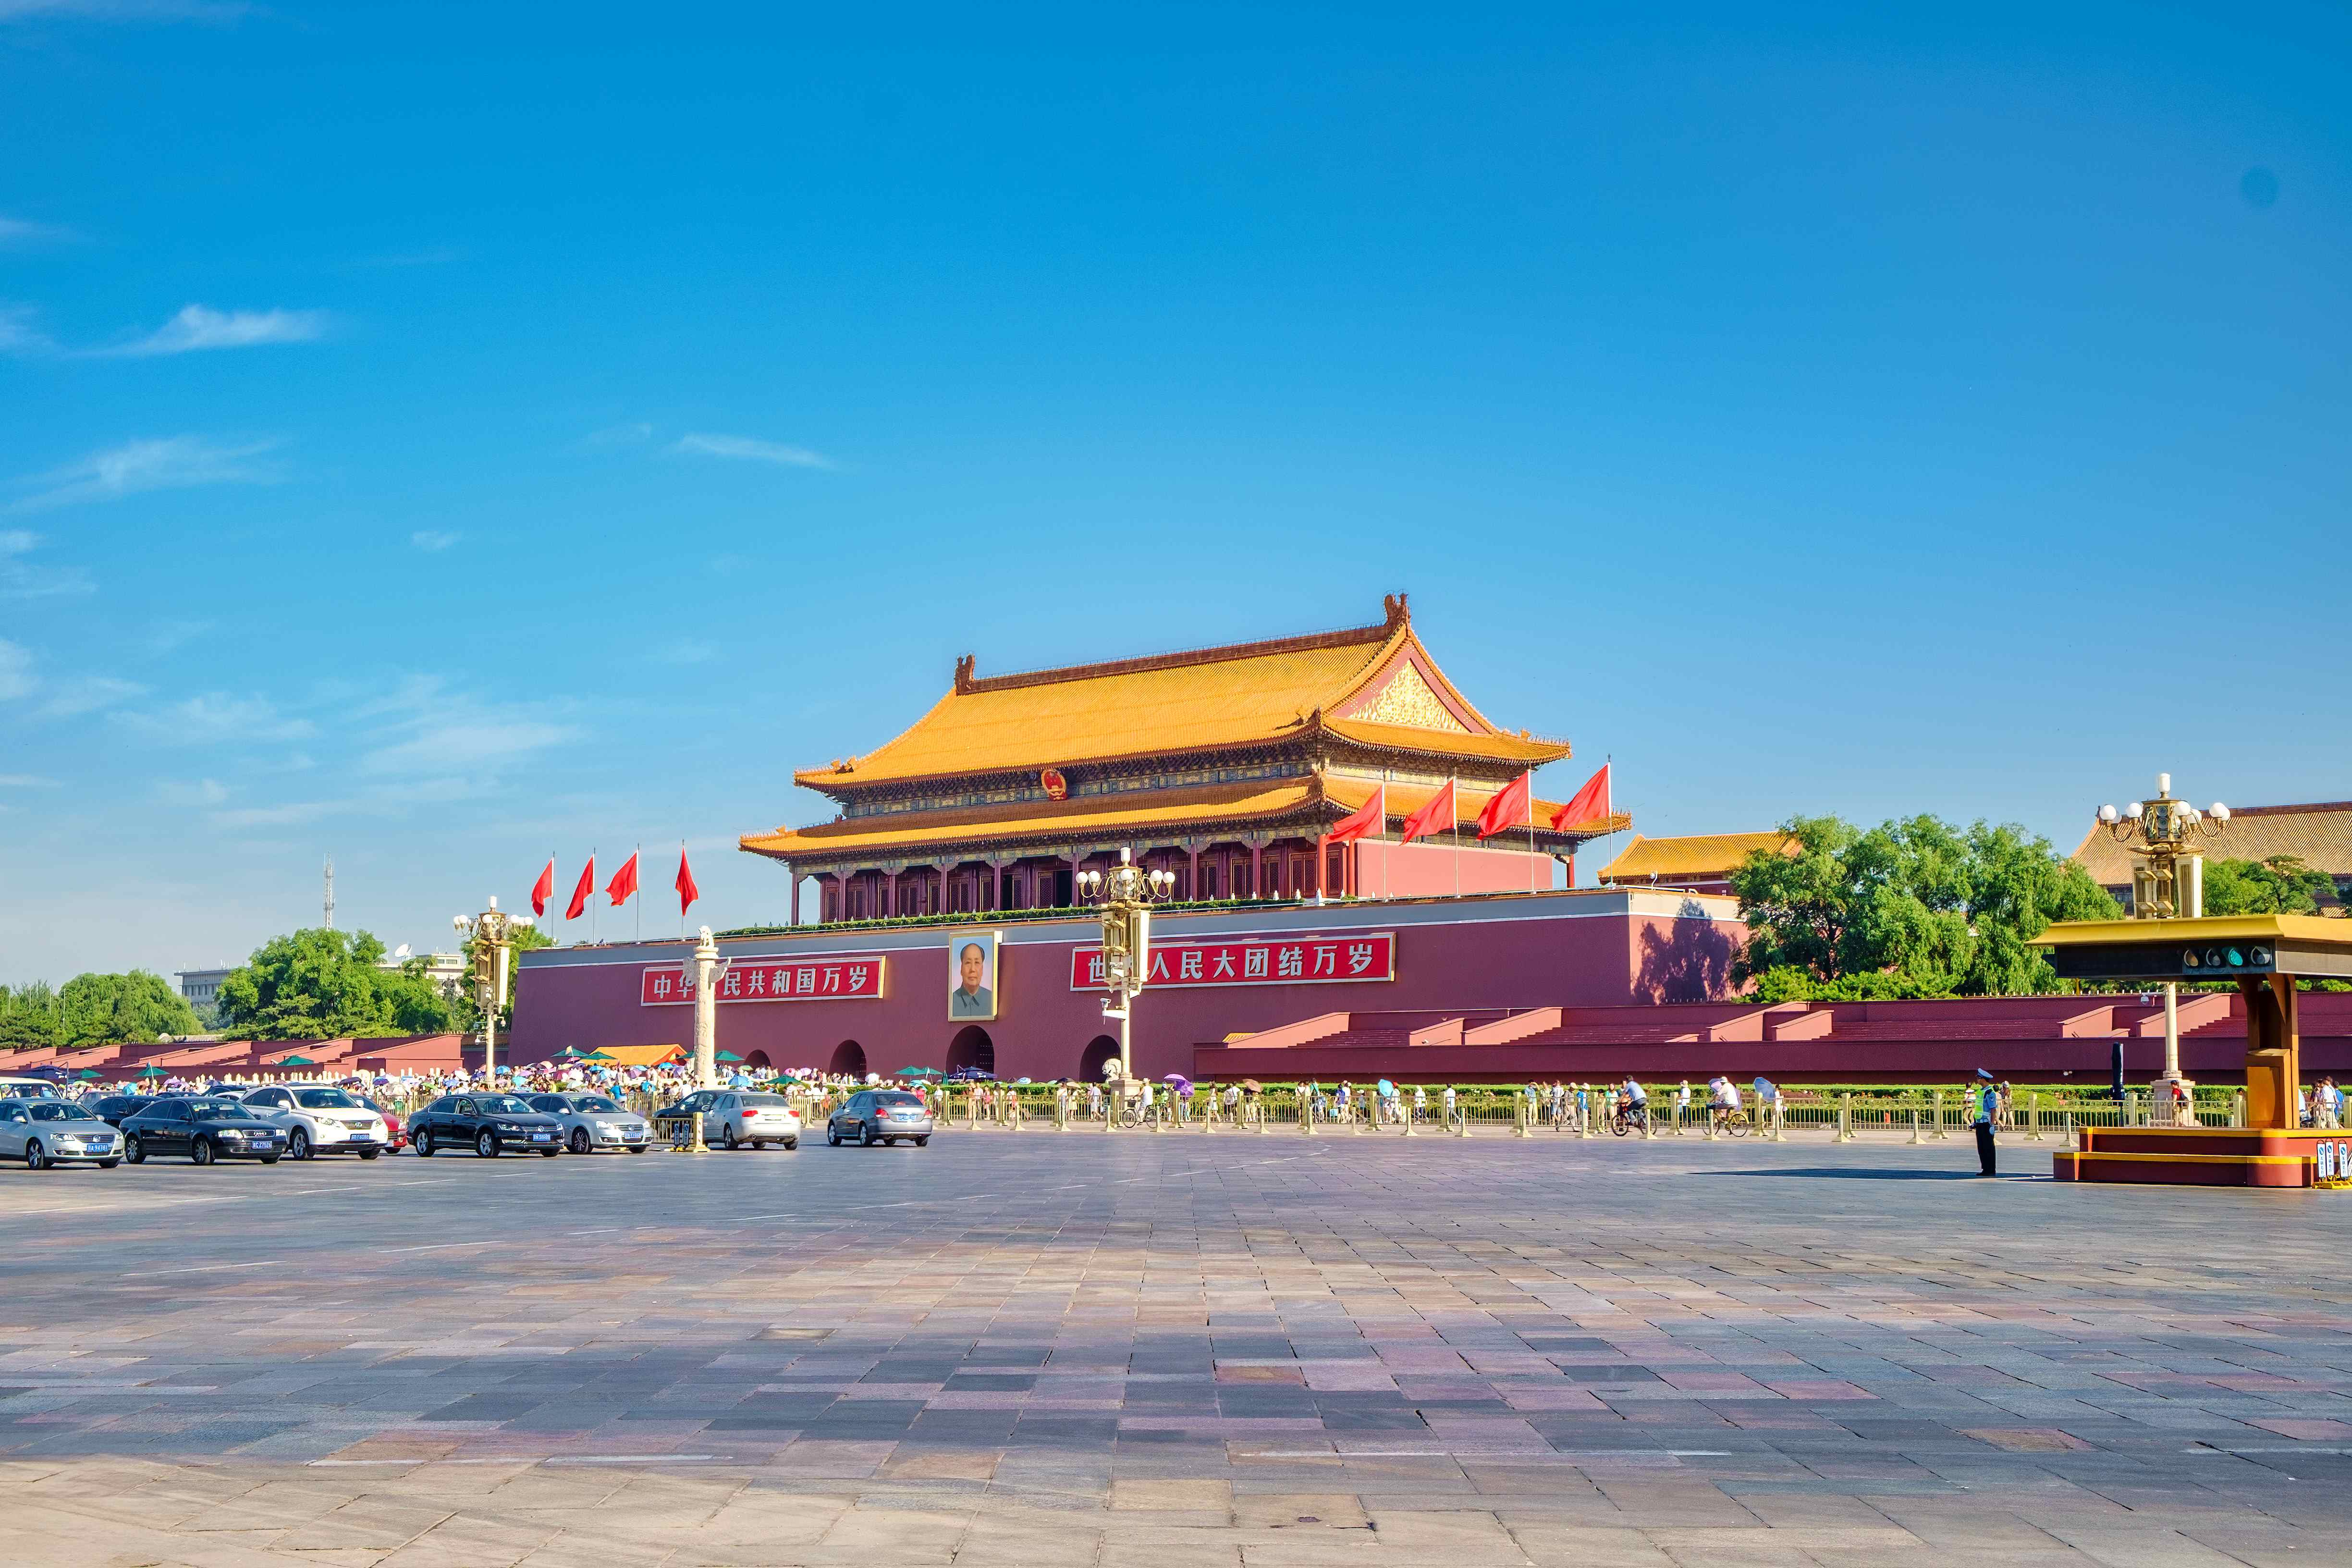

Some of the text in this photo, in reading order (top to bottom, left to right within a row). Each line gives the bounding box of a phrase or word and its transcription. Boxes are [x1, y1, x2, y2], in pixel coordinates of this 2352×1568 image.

[1088, 943, 1373, 983] 世人民大团结万岁
[654, 966, 868, 999] 中华民共和国万岁
